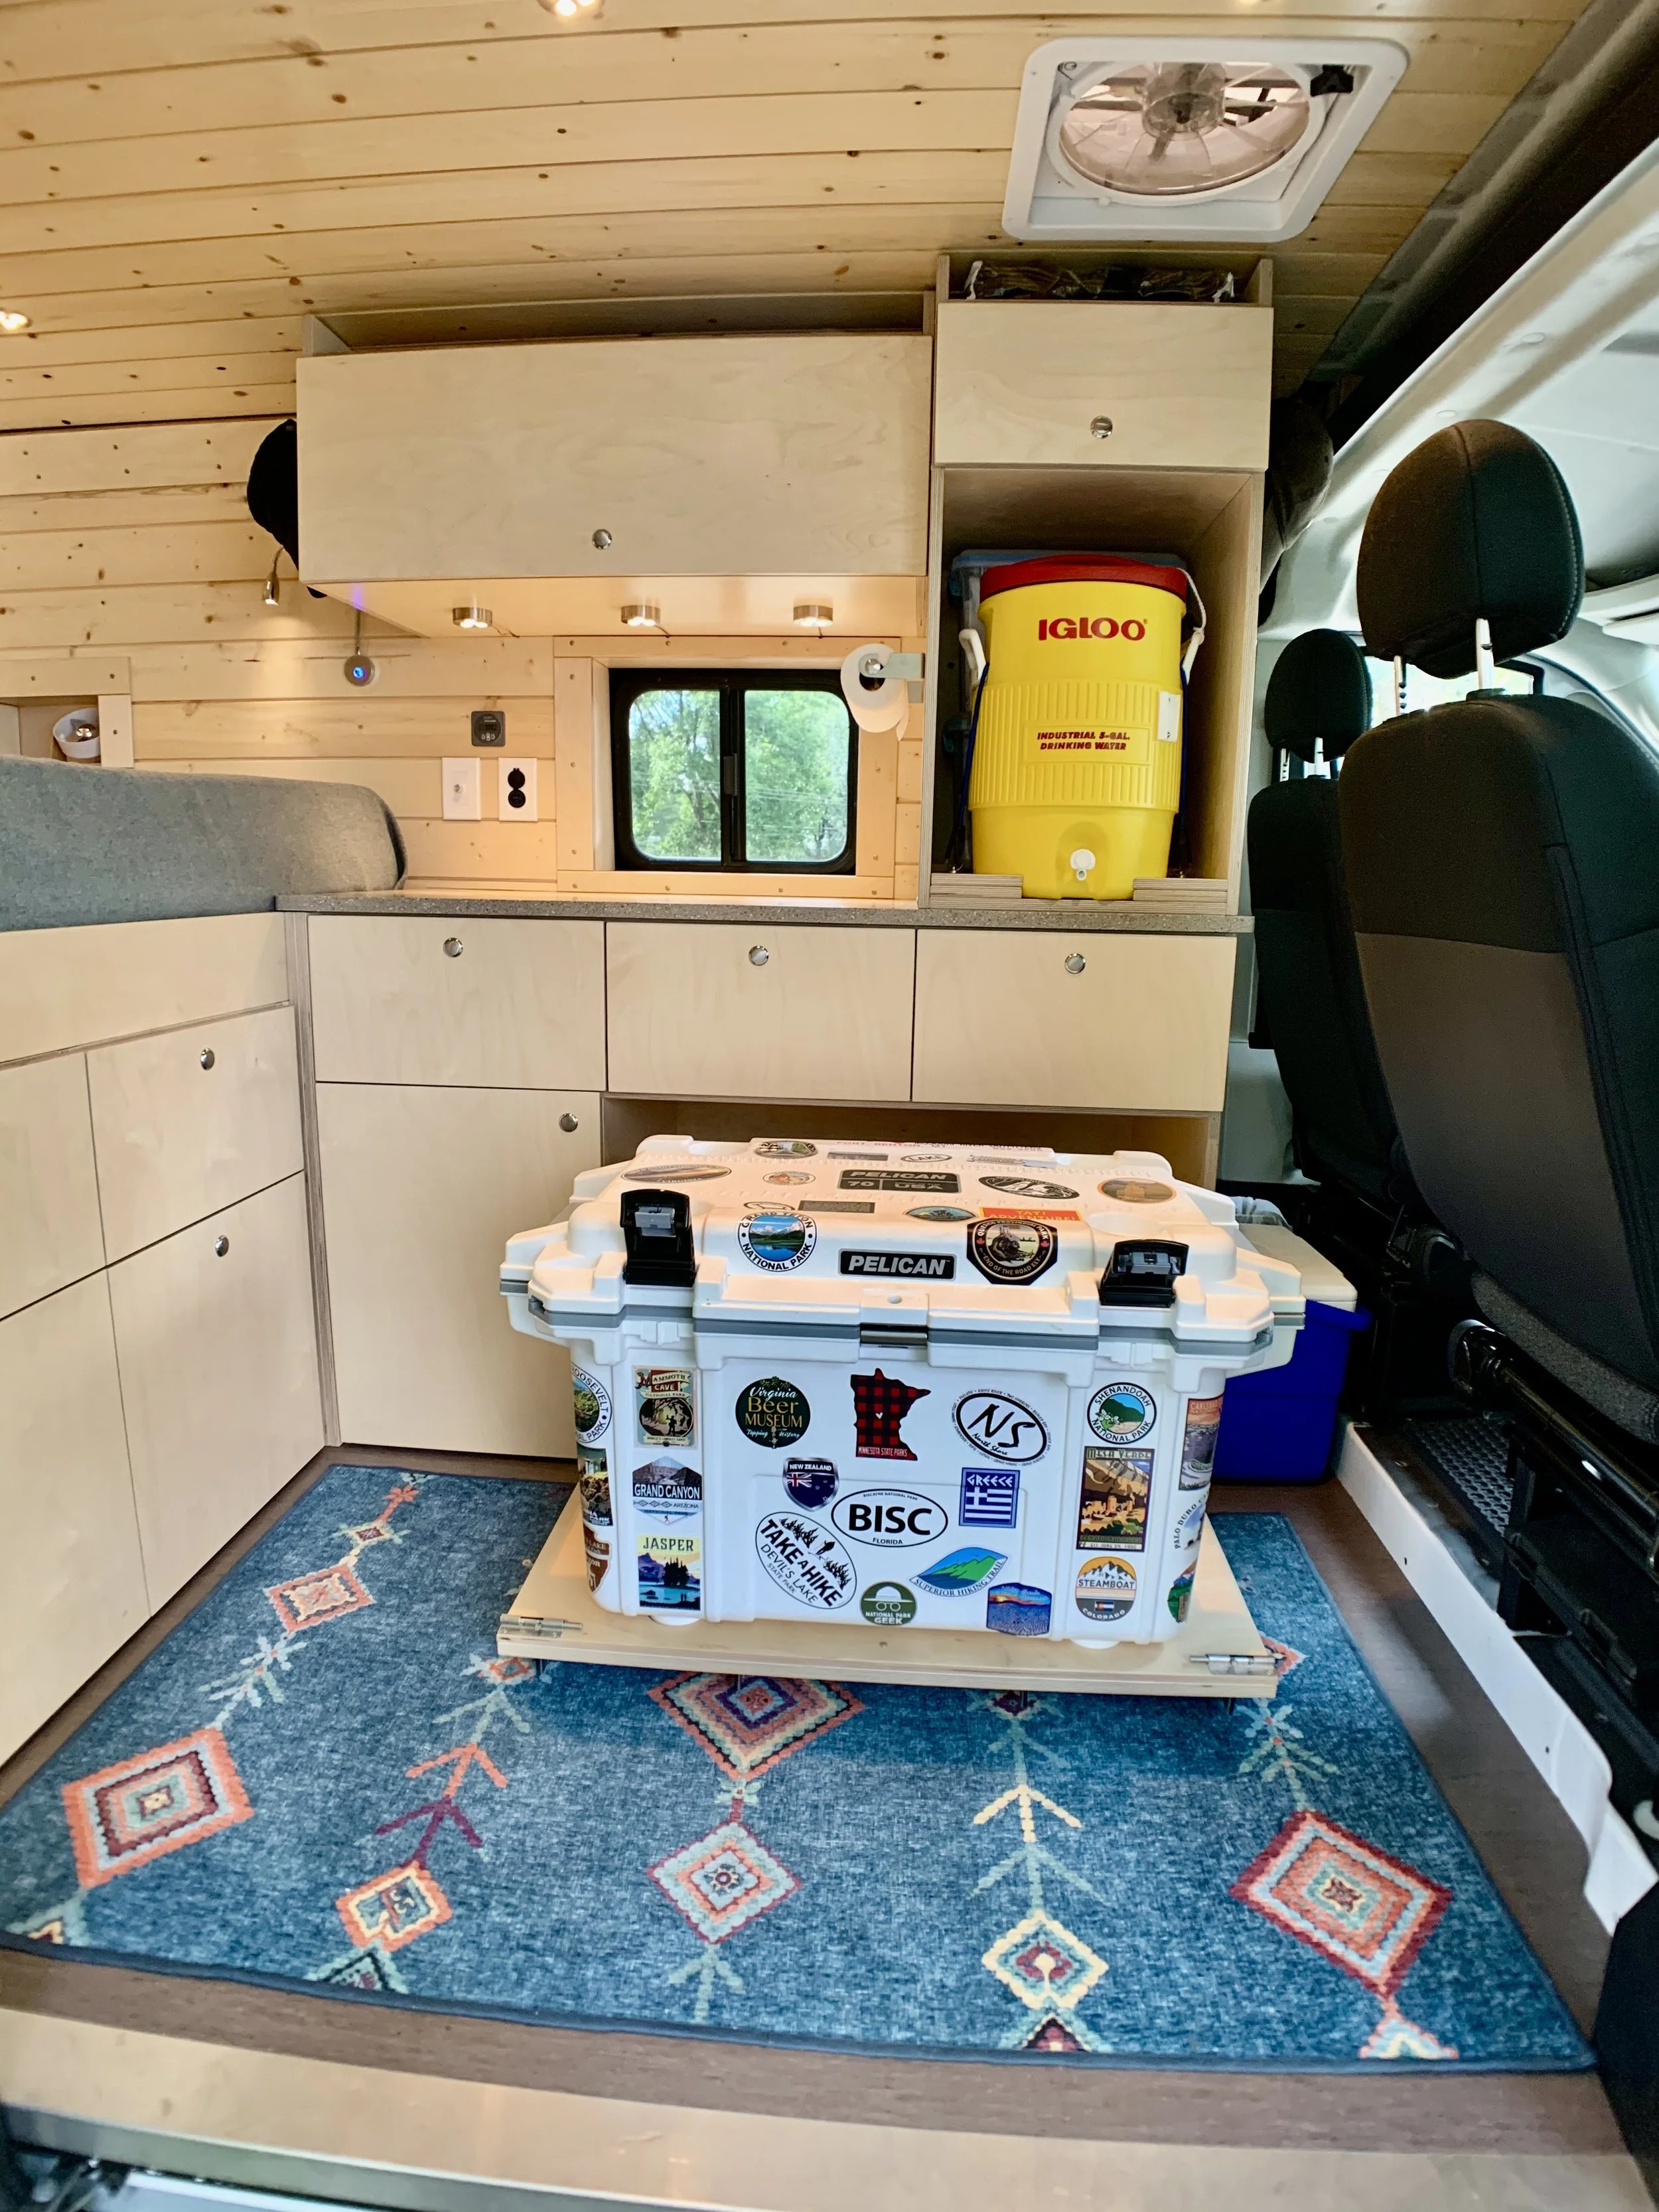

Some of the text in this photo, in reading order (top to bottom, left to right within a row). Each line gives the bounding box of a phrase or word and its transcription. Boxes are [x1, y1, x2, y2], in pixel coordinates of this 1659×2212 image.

[1038, 617, 1146, 641] IGLOO
[1037, 731, 1131, 740] INDUSTRIAL 5-GAL.
[1040, 741, 1127, 751] DRINKING WATER
[908, 1153, 944, 1162] LAKE
[849, 1171, 948, 1180] PELICAN
[1036, 1225, 1049, 1240] PARK
[742, 1242, 813, 1271] NATIONAL PARK
[848, 1255, 947, 1276] PELICAN
[983, 1255, 994, 1267] END
[993, 1265, 1001, 1274] OF
[1015, 1266, 1032, 1275] ROAD
[1031, 1257, 1042, 1268] ELY
[749, 1386, 798, 1402] Virginia
[1094, 1386, 1151, 1407] SHENANDOAH
[748, 1396, 799, 1414] Beer
[745, 1412, 802, 1428] MUSEUM
[967, 1403, 1037, 1448] NS
[587, 1421, 607, 1441] PARK
[747, 1428, 768, 1438] Tapping
[1092, 1419, 1151, 1442] NATIONAL PARK
[858, 1445, 908, 1457] MINNESOTA STATE PARKS
[972, 1432, 992, 1448] North
[990, 1445, 1008, 1456] Shore
[966, 1473, 1013, 1488] GREECE
[634, 1483, 700, 1500] GRAND CANYON
[849, 1503, 932, 1536] BISC
[1178, 1503, 1197, 1526] DURO
[642, 1537, 694, 1552] JASPER
[760, 1518, 843, 1607] TAKE A HIKE
[760, 1543, 818, 1604] DEVIL'S LAKE
[766, 1563, 797, 1594] STATE PARK
[915, 1578, 956, 1596] SUPERIOR
[957, 1580, 988, 1596] HIKING
[986, 1560, 1004, 1581] TRAIL
[1078, 1579, 1135, 1589] STEAMBOAT
[1082, 1607, 1126, 1620] COLORADO
